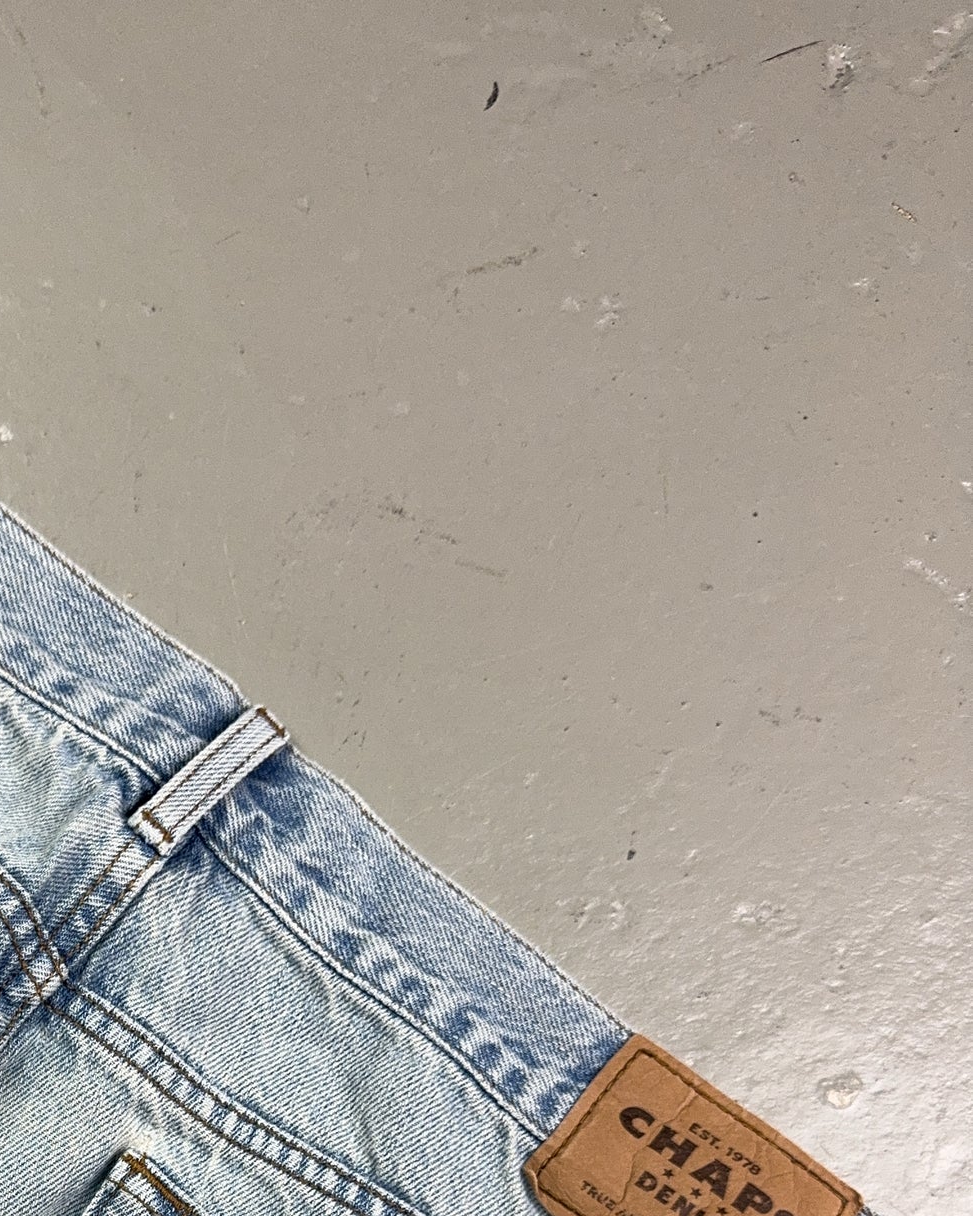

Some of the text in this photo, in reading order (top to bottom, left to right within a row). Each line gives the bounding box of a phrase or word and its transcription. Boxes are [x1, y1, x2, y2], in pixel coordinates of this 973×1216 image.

[687, 1123, 762, 1175] EST. 1978
[580, 1180, 617, 1211] TRUE
